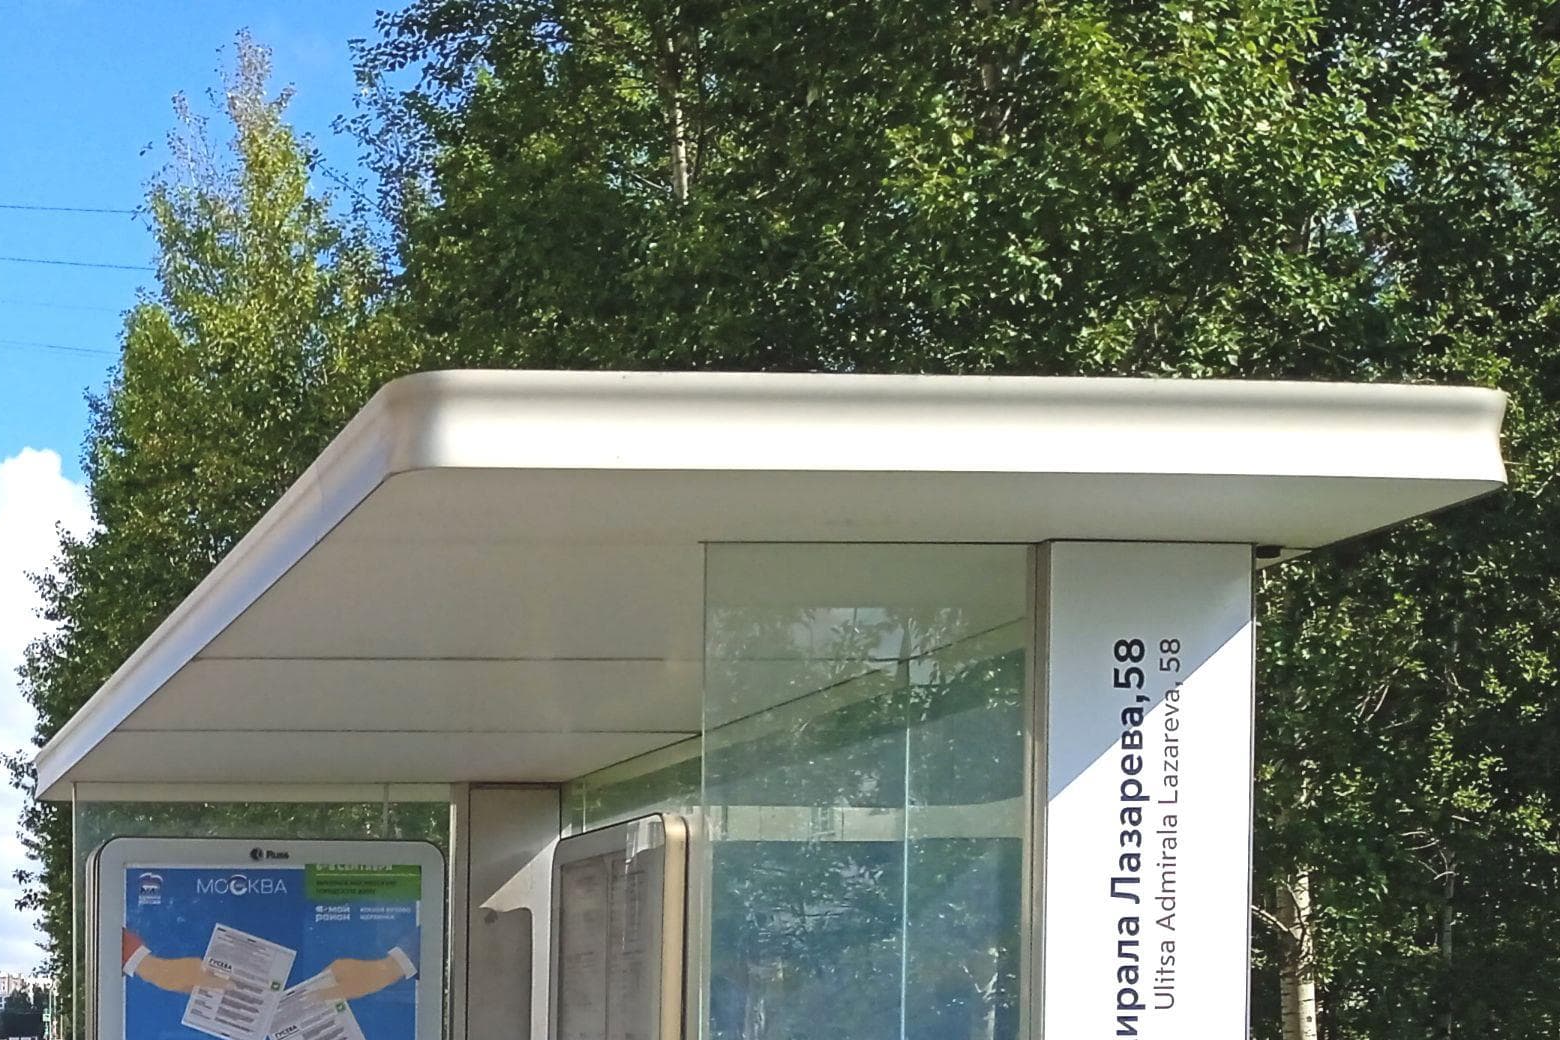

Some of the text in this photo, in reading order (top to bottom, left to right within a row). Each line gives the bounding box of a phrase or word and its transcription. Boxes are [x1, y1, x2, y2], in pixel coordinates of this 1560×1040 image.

[197, 874, 287, 896] МОСКВА
[1153, 638, 1183, 1010] Ulitsa Admirala Lazareva, 58
